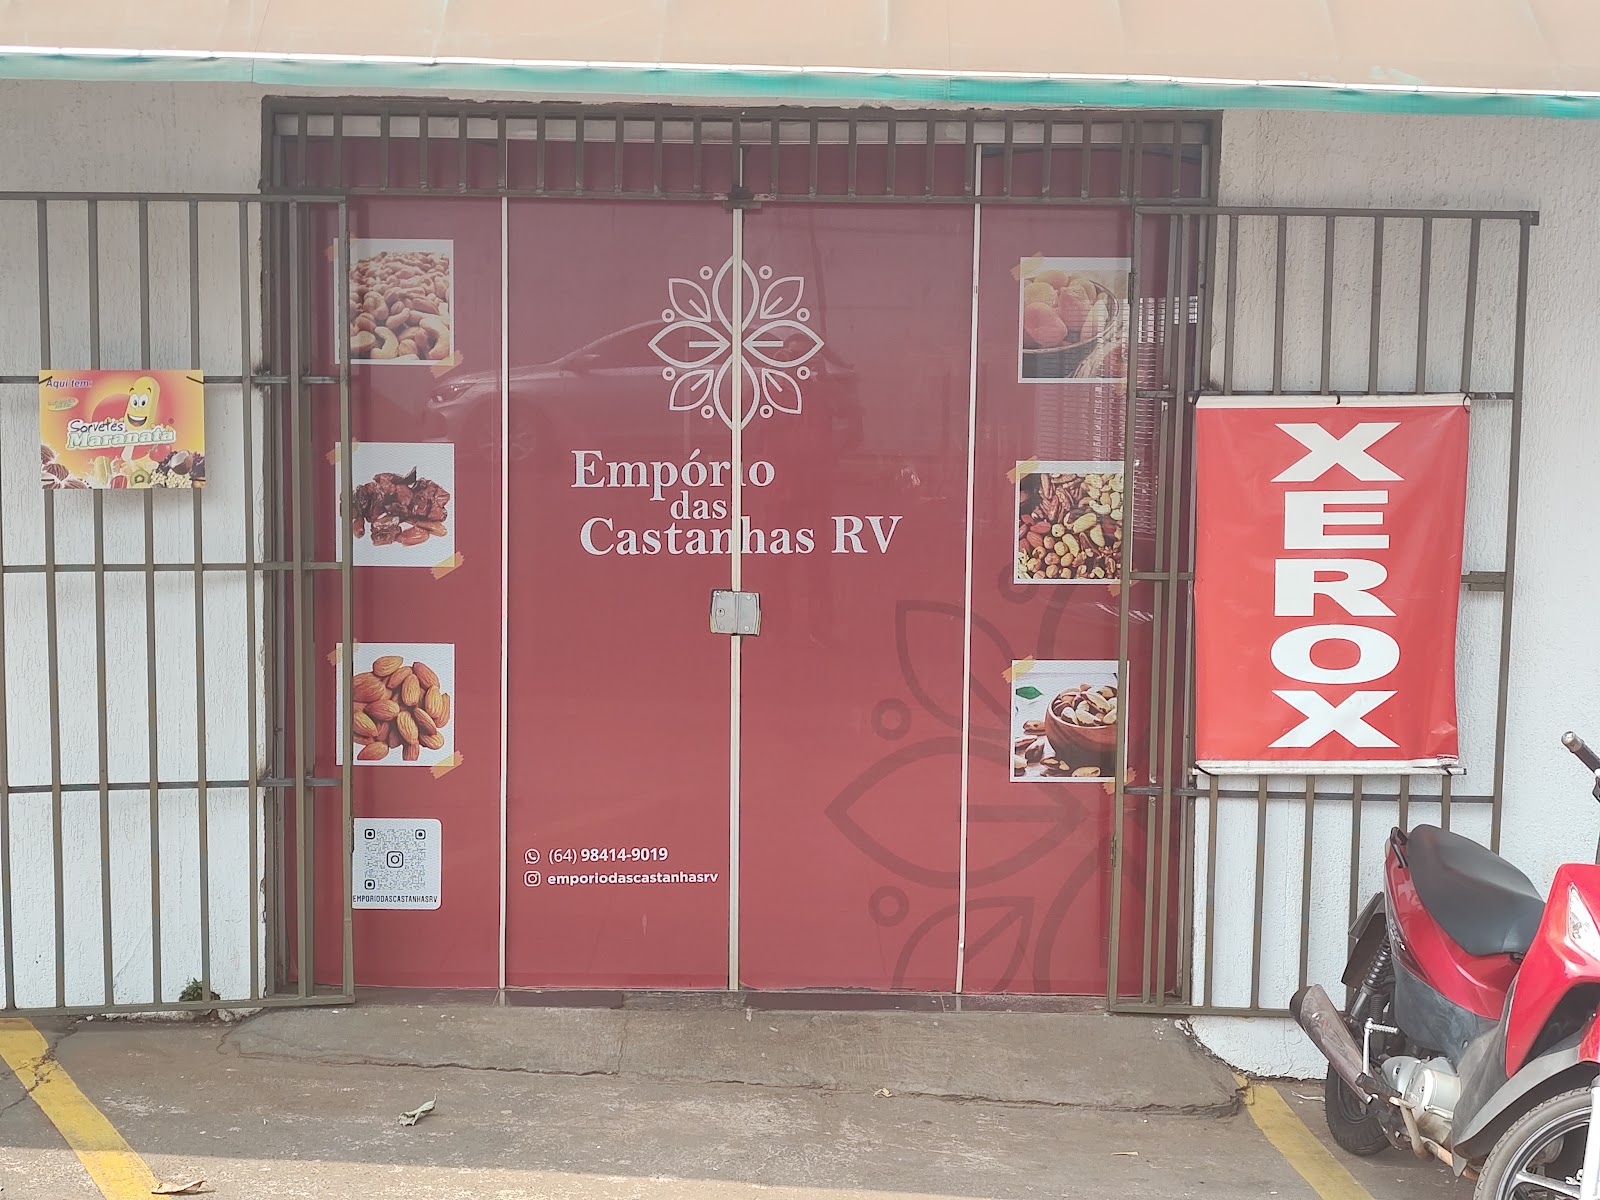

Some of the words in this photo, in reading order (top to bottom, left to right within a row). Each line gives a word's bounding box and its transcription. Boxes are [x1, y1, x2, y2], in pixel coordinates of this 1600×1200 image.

[46, 378, 68, 390] Aqui
[71, 379, 93, 388] tem:
[69, 419, 124, 434] Sorvetes
[68, 427, 175, 449] Maranata
[571, 448, 776, 501] Empóro
[670, 490, 728, 520] das
[579, 515, 815, 556] Castanhas
[831, 515, 904, 554] RV
[1267, 421, 1405, 748] XEROX
[548, 848, 577, 865] (64)
[580, 847, 669, 862] 98414-9019
[547, 871, 719, 886] emporiodascastanhasrv
[352, 895, 438, 903] EMPORIODASCASTANHASRV
